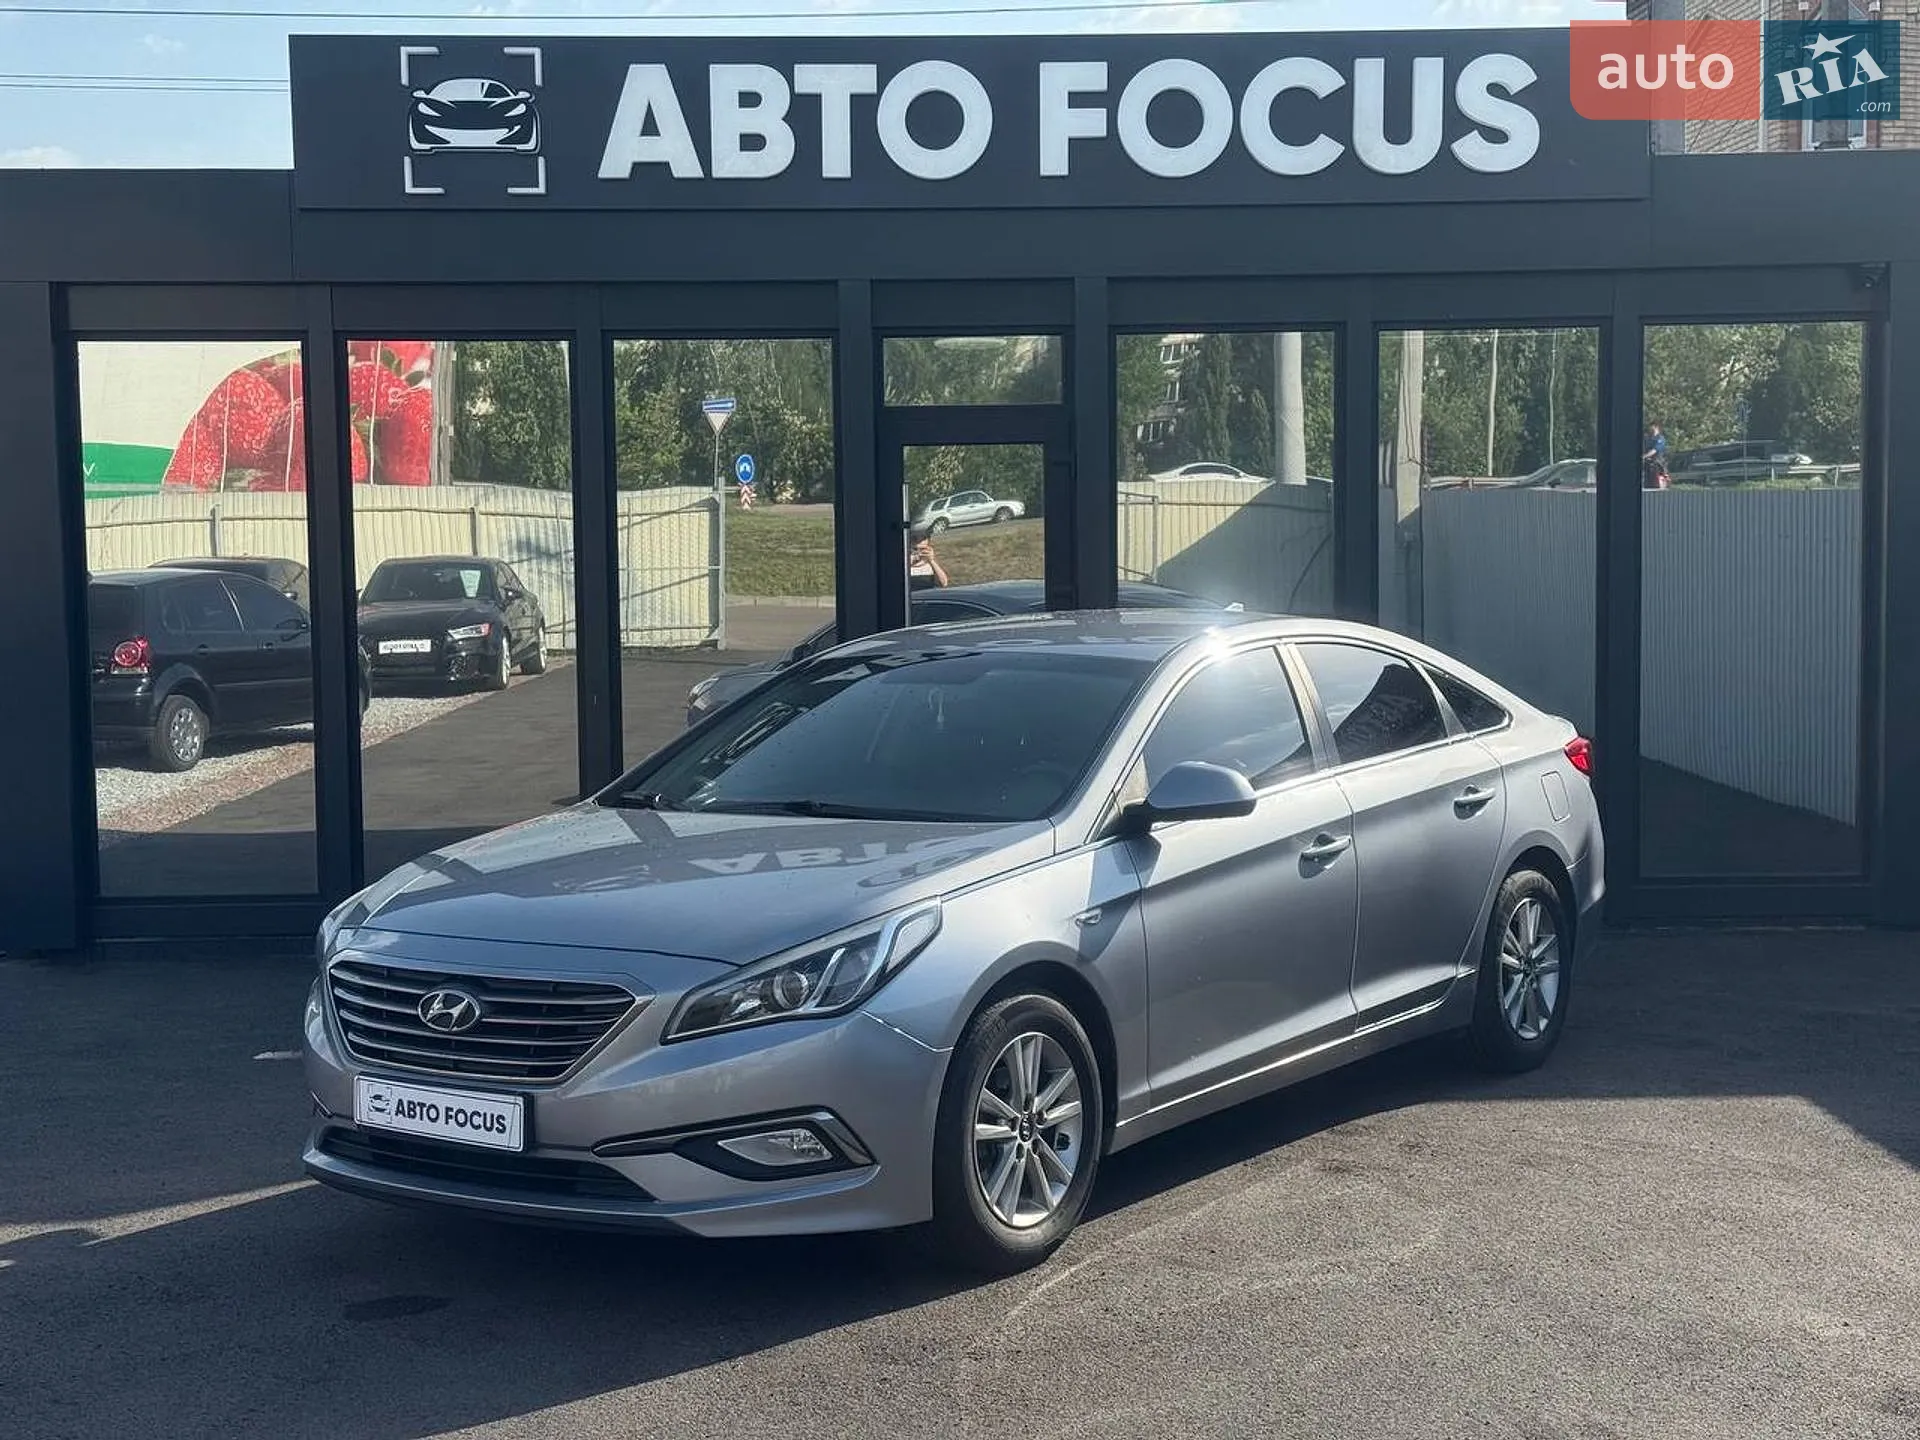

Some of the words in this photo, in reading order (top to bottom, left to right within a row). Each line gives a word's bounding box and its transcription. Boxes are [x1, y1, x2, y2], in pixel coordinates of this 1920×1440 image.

[598, 60, 992, 179] АВТО
[1040, 54, 1540, 176] FOCUS
[395, 1098, 440, 1123] АВТО
[444, 1106, 507, 1134] FOCUS
